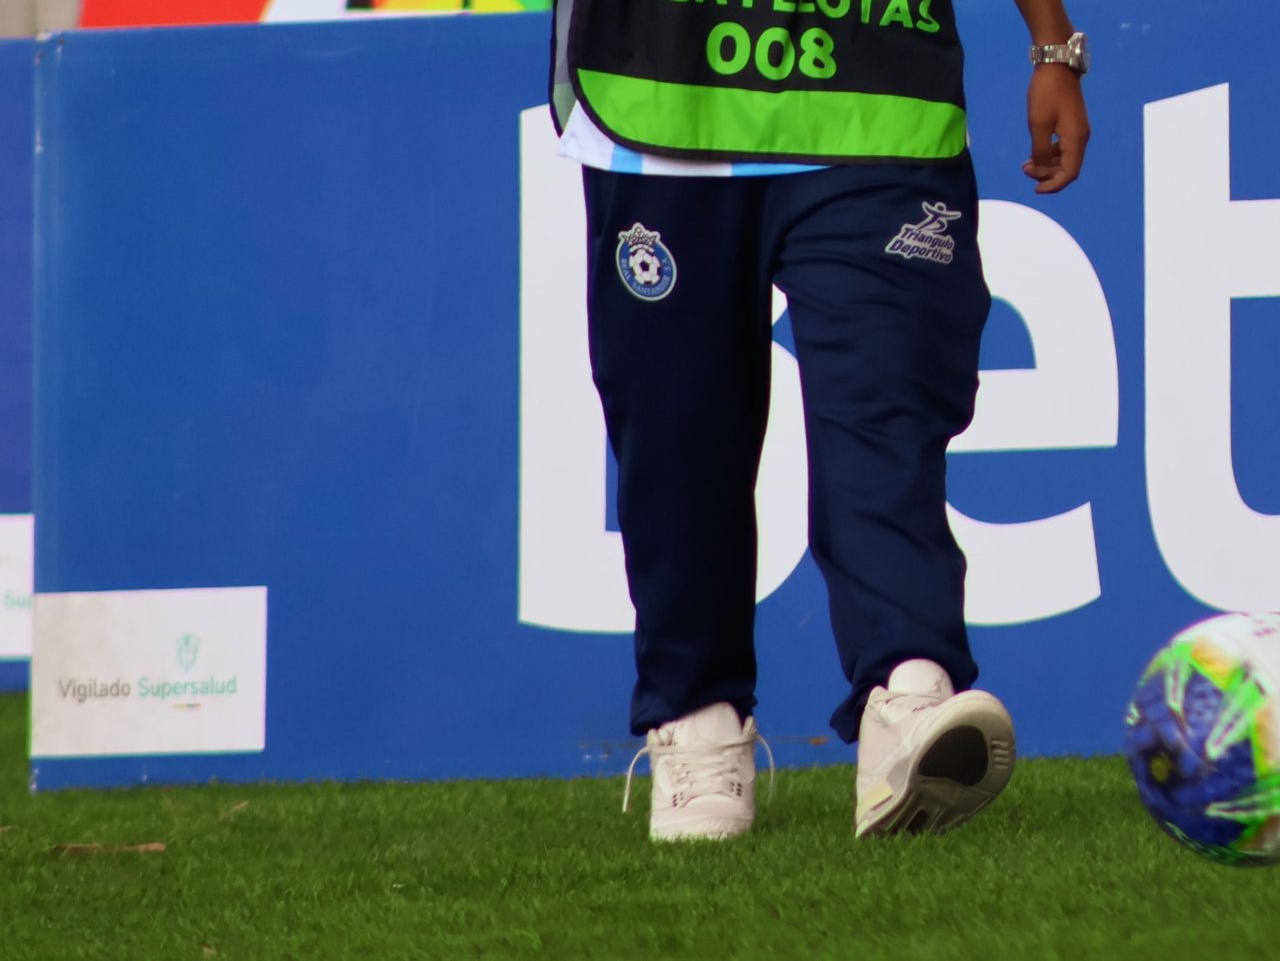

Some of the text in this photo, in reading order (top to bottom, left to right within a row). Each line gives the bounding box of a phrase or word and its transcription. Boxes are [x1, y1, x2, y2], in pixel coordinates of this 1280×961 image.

[890, 239, 952, 261] Deportivo
[901, 227, 953, 250] Triangulo
[58, 675, 237, 703] Vigilado Supersalud
